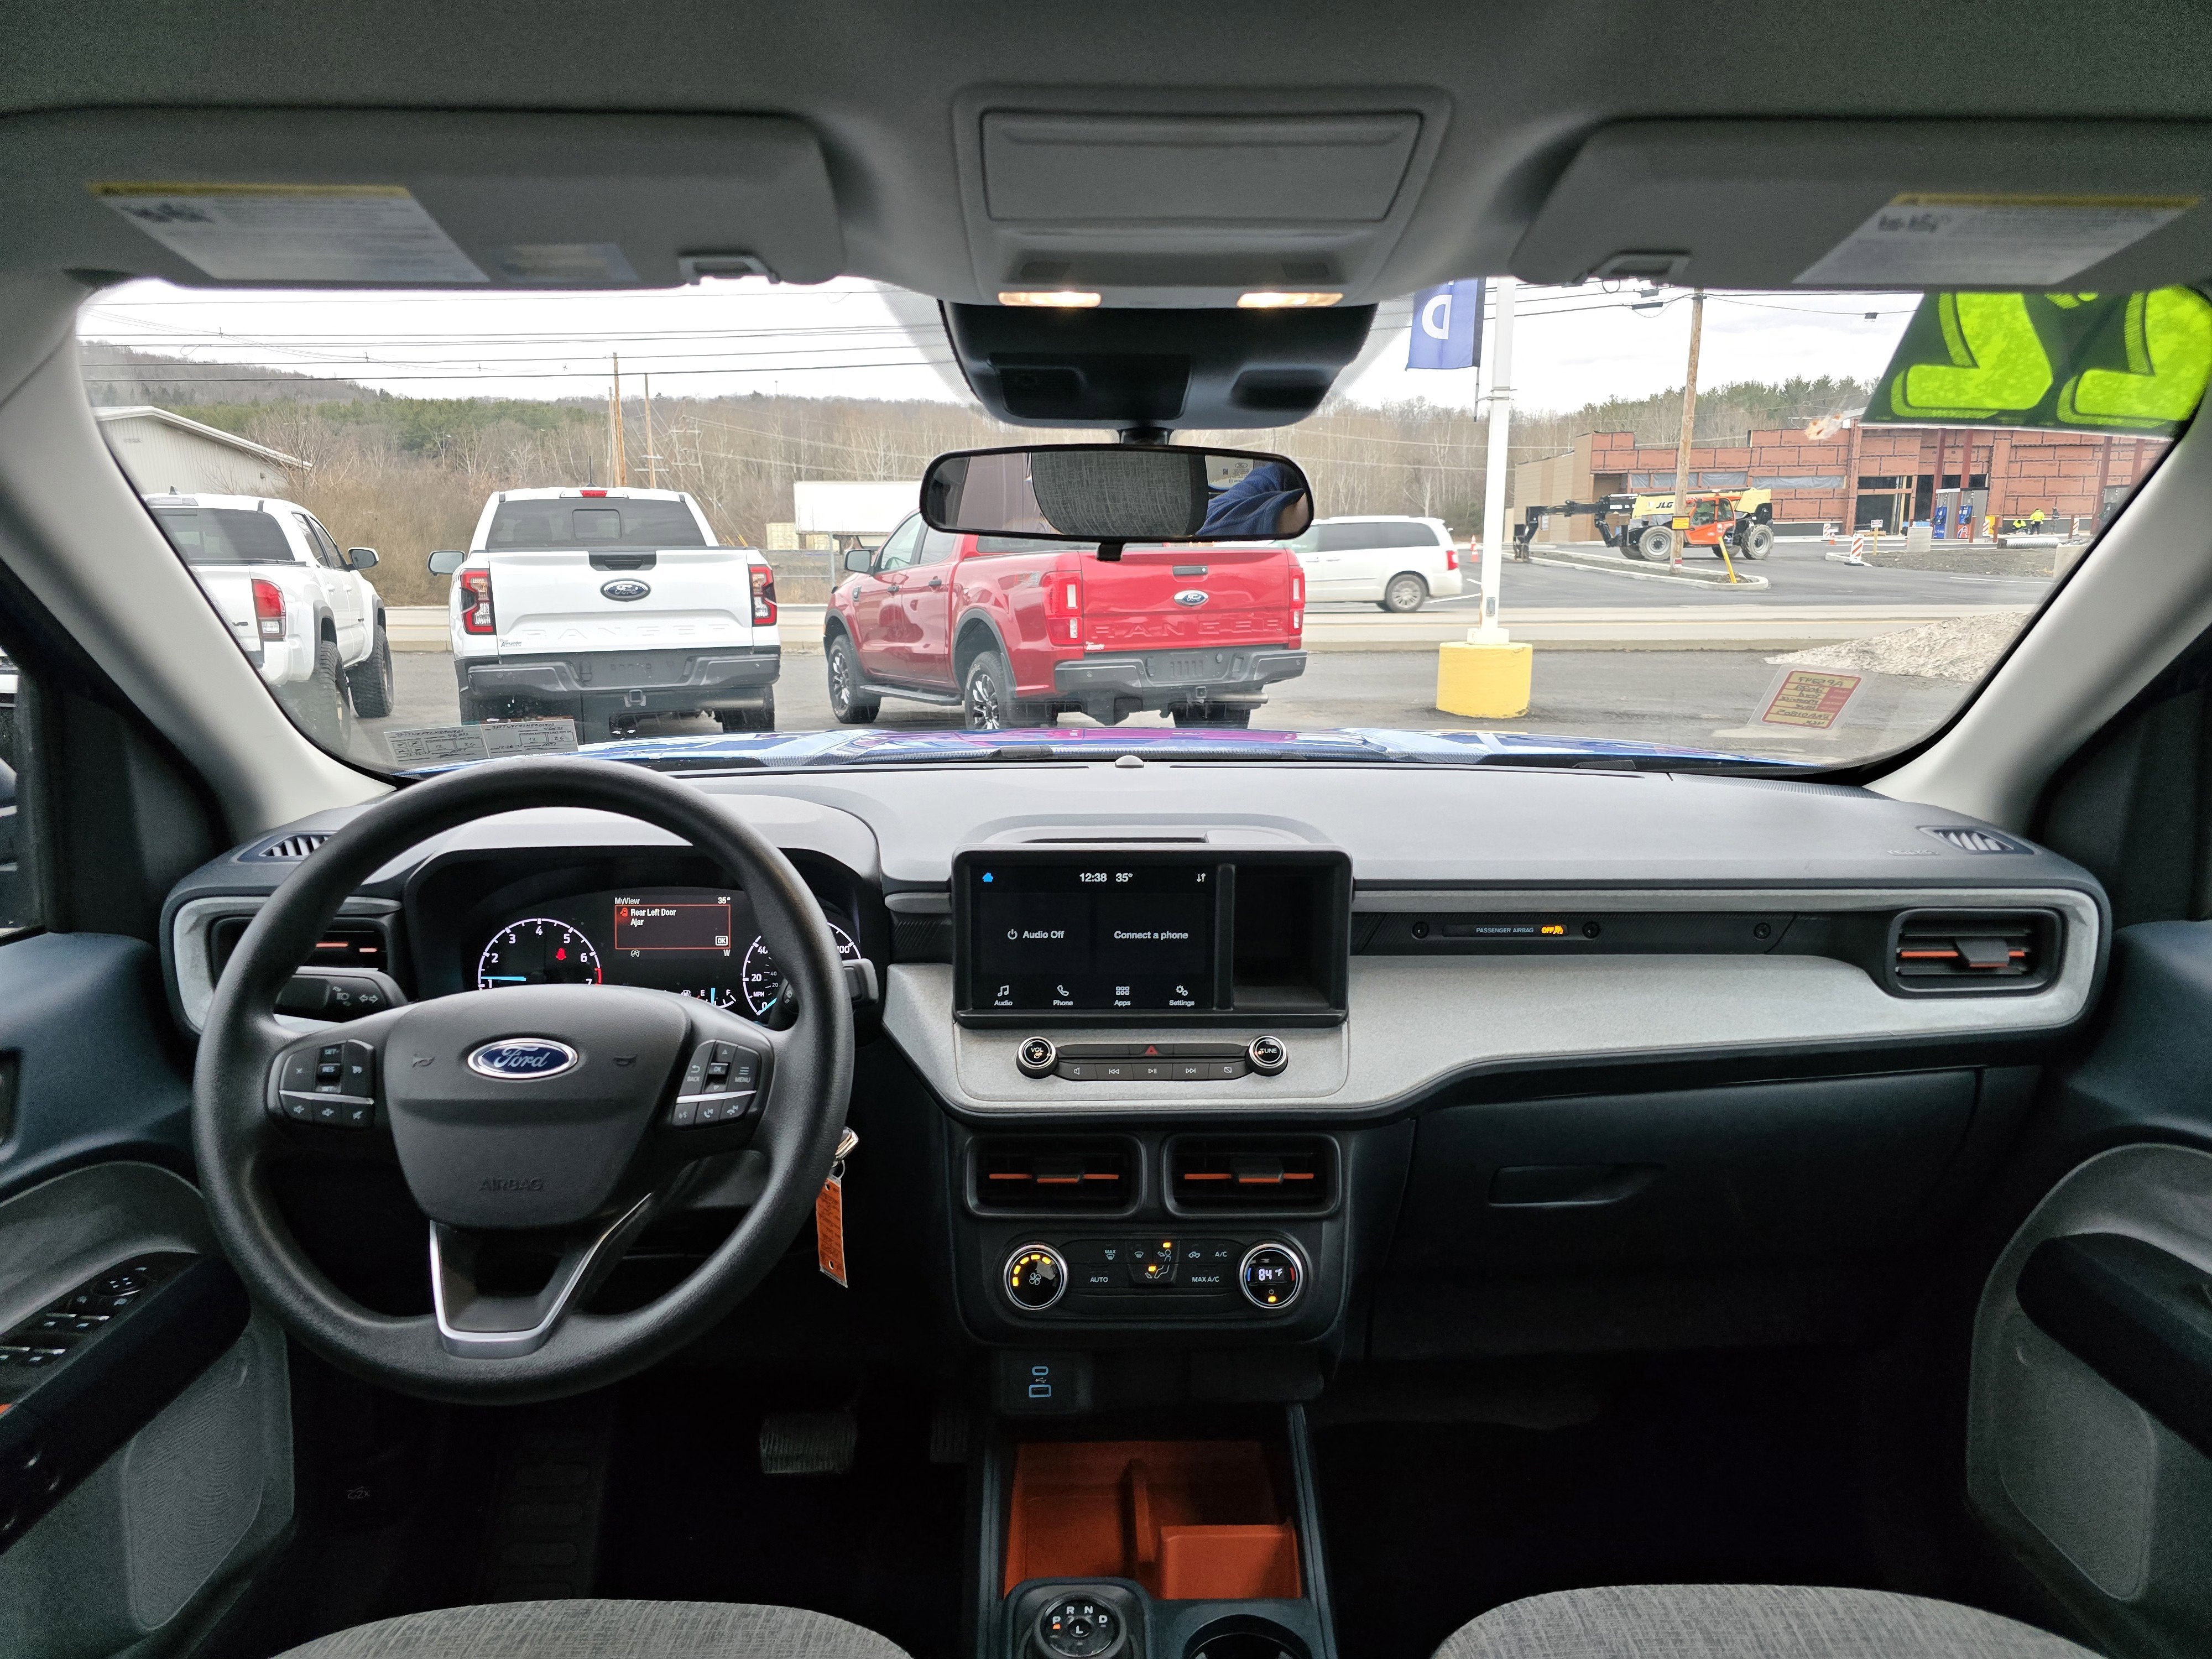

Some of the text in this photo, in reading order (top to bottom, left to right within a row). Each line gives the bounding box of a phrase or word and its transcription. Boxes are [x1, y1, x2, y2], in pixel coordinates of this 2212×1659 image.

[1092, 617, 1283, 639] RANGER
[1079, 873, 1107, 883] 12:38
[1115, 873, 1133, 883] 35°
[614, 897, 640, 905] MyView
[630, 918, 644, 927] Ajar
[536, 926, 543, 936] 4
[1022, 930, 1065, 939] Audio Off
[1114, 931, 1151, 940] Connect
[1160, 931, 1188, 941] phone
[509, 933, 516, 944] 3
[564, 933, 571, 943] 5
[491, 953, 499, 963] 2
[580, 952, 588, 963] 6
[751, 973, 762, 982] 20
[493, 1046, 550, 1068] Ford
[479, 1178, 544, 1191] AIRBAG
[1258, 1268, 1272, 1281] 84
[1052, 1605, 1108, 1624] P R N D
[1076, 1625, 1084, 1634] L
